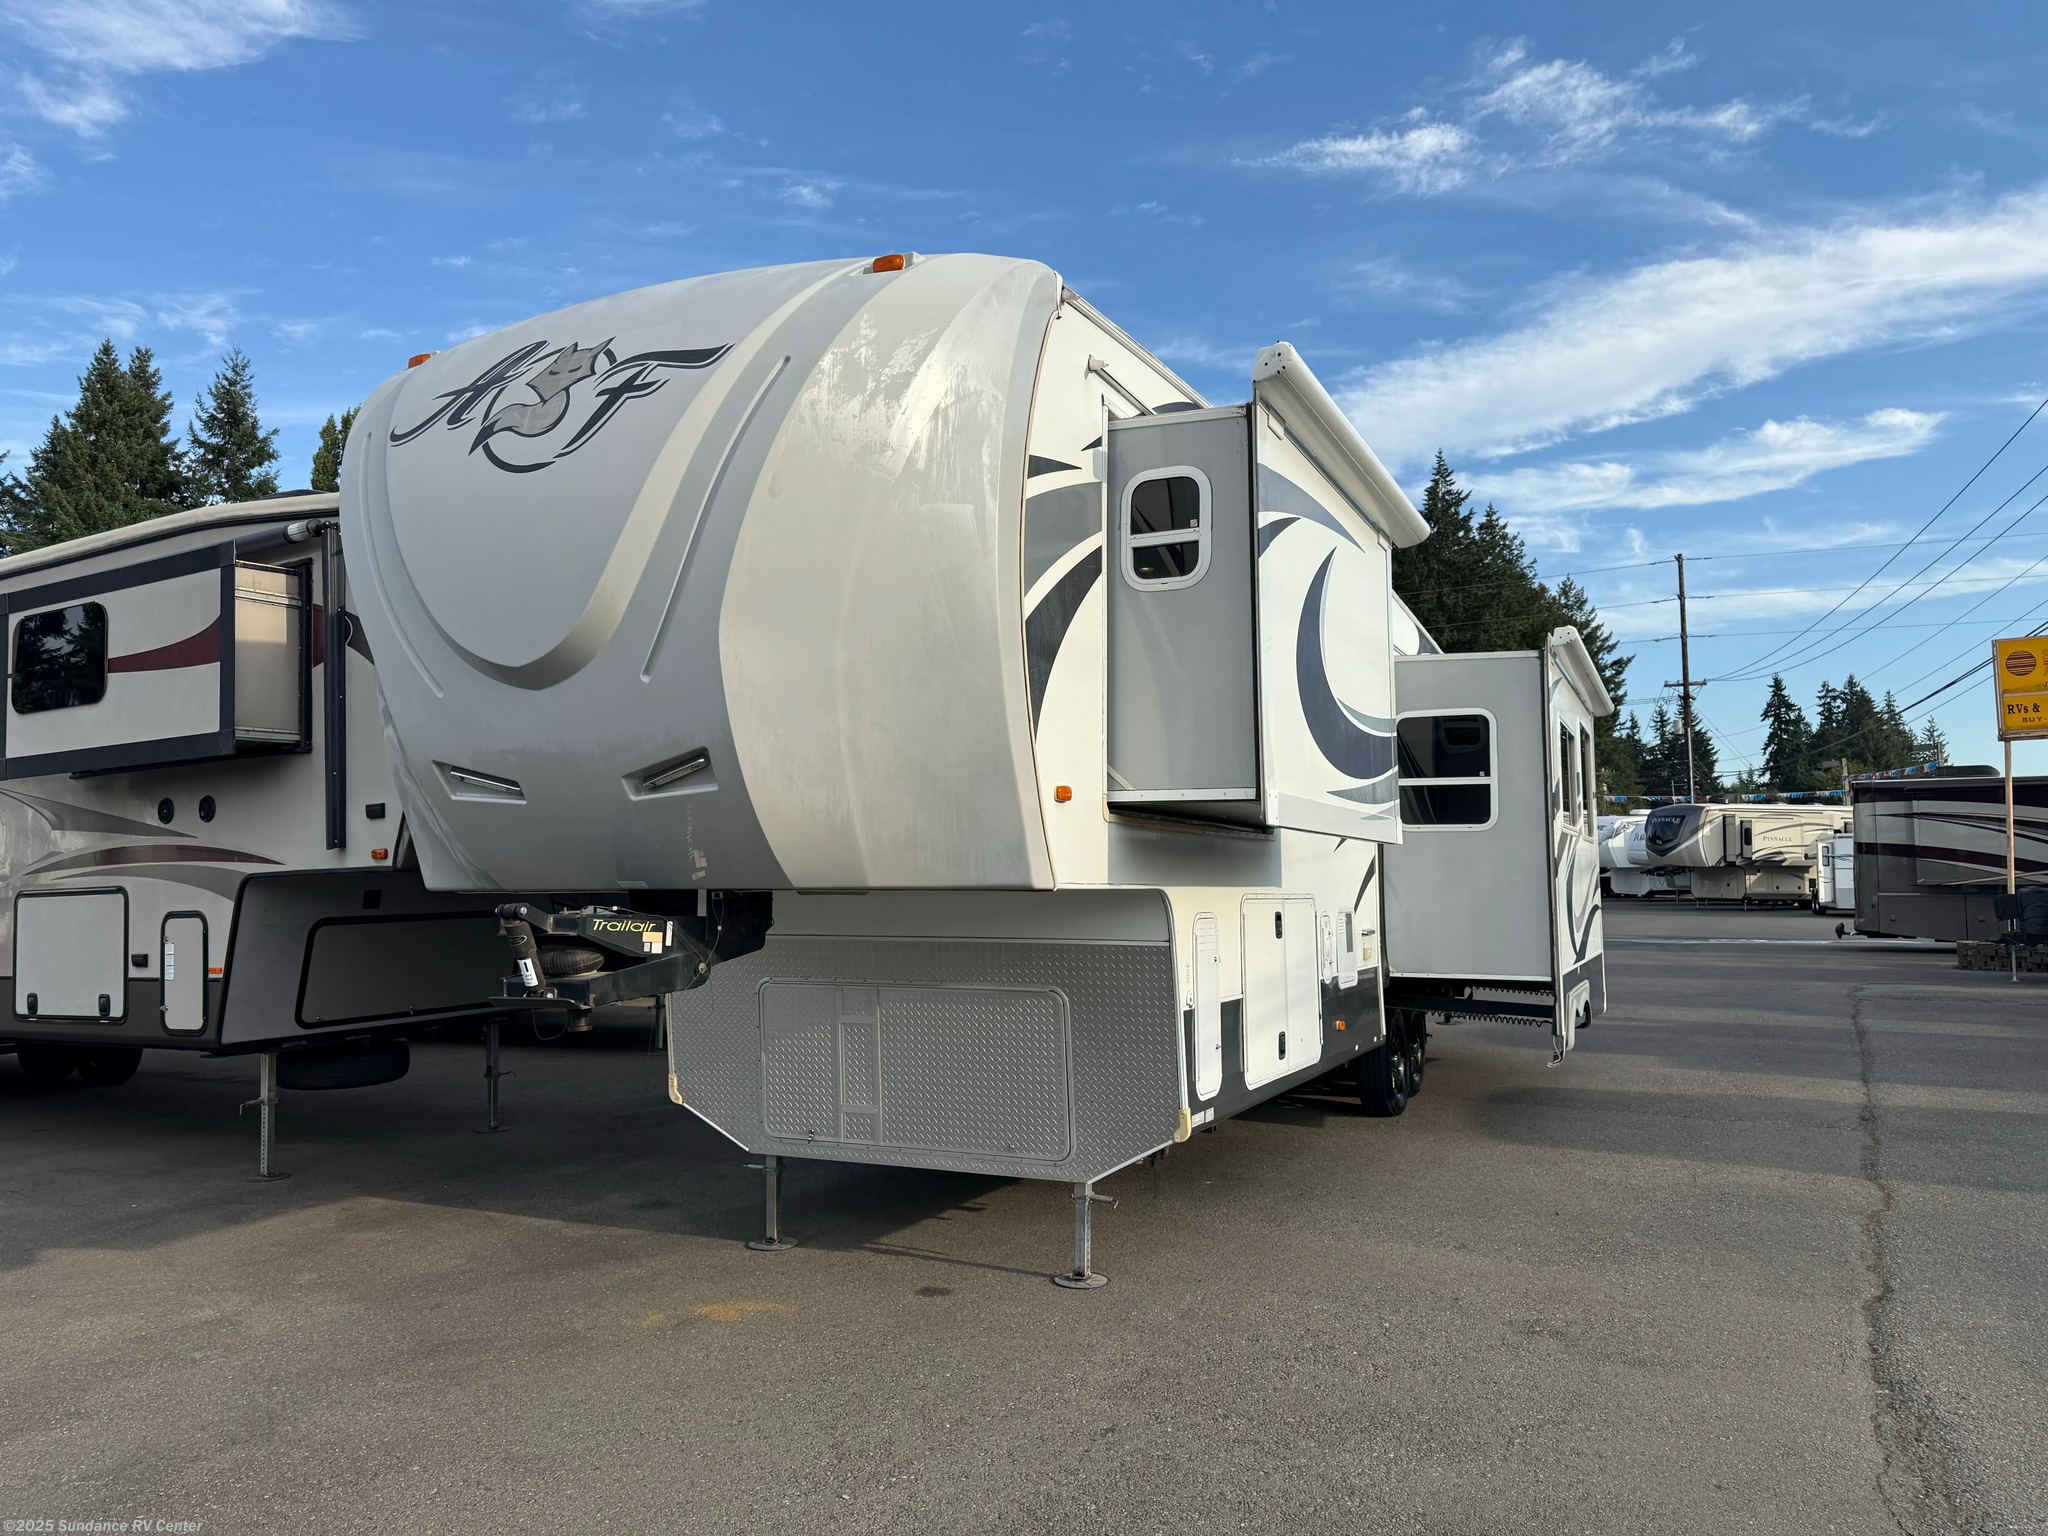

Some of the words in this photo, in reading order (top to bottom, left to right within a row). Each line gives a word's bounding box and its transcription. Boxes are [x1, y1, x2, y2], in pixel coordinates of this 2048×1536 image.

[2007, 703, 2029, 715] RVs
[2032, 702, 2041, 713] &
[593, 918, 657, 932] Trailair
